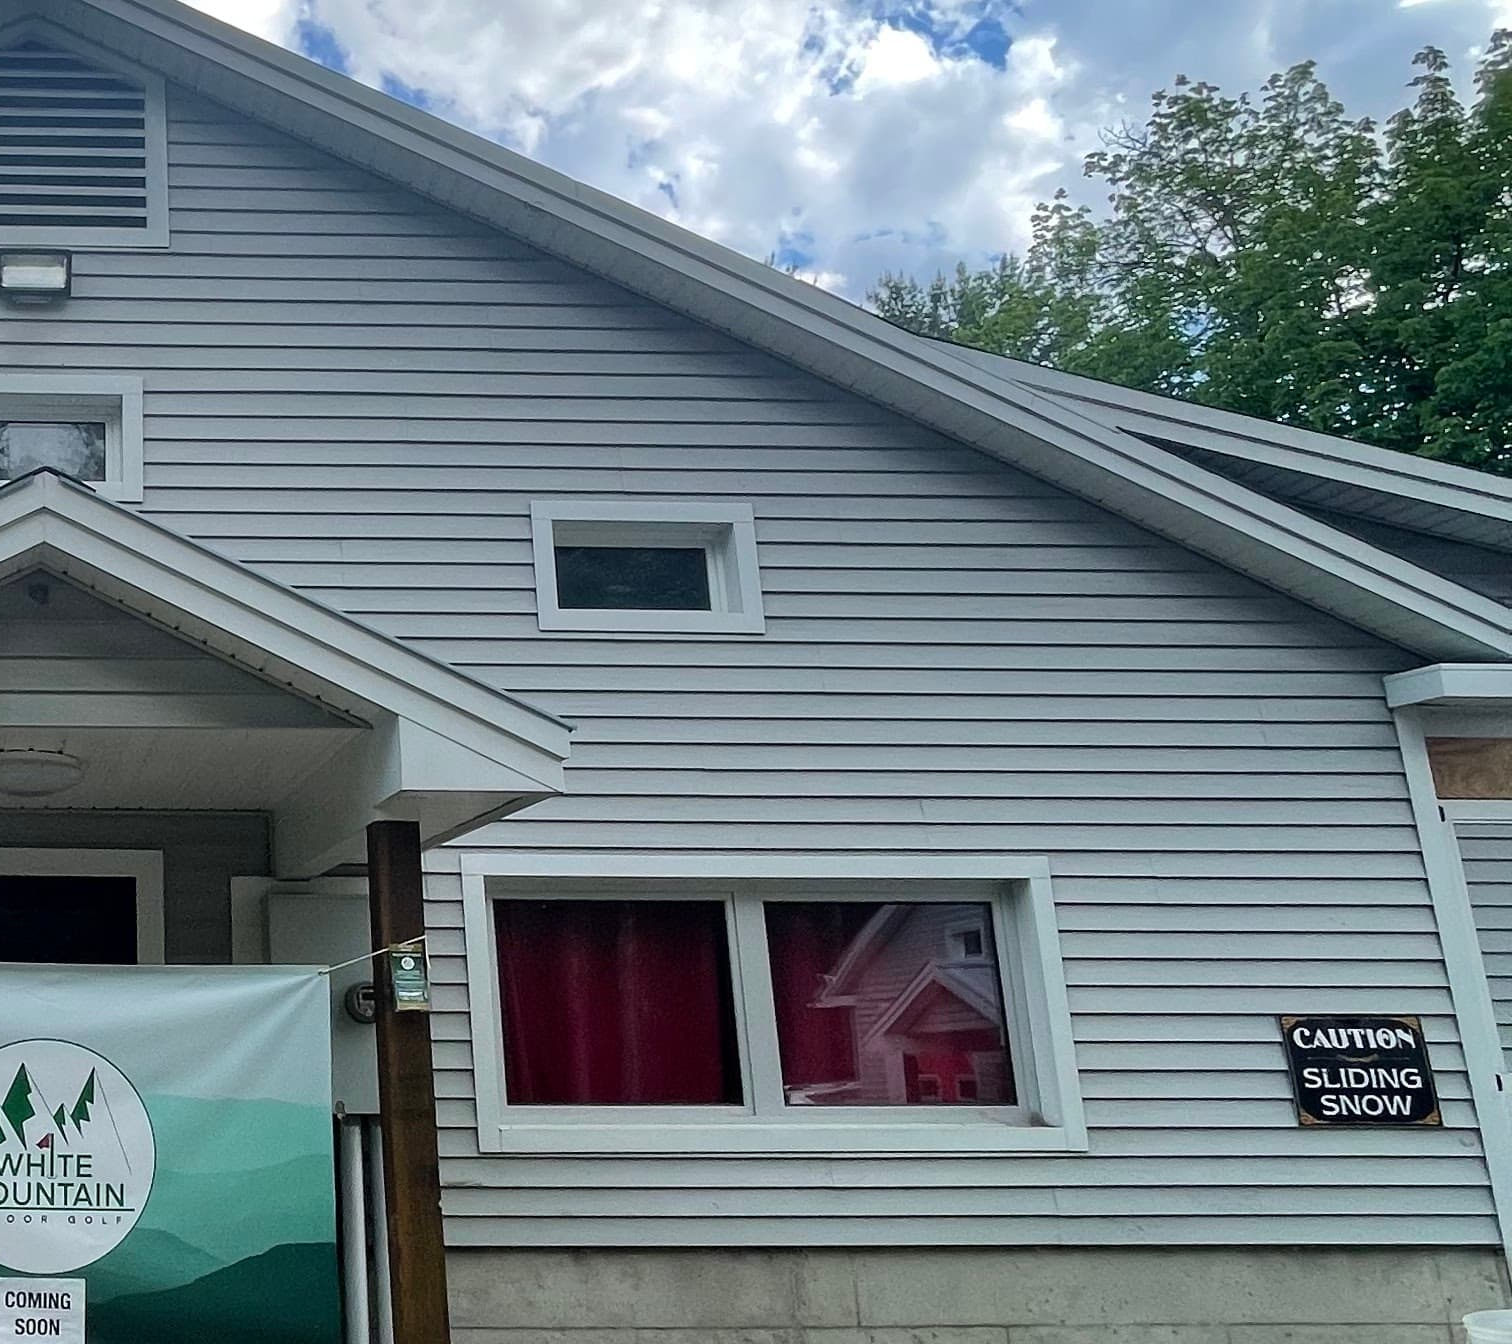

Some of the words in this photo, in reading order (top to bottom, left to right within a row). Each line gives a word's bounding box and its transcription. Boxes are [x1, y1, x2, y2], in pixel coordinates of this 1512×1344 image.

[1292, 1027, 1416, 1049] CAUTION
[1303, 1067, 1423, 1089] SLIDING
[1320, 1094, 1412, 1116] SNOW
[67, 1214, 123, 1226] GOLF
[4, 1290, 72, 1310] COMING
[14, 1318, 61, 1336] SOON
